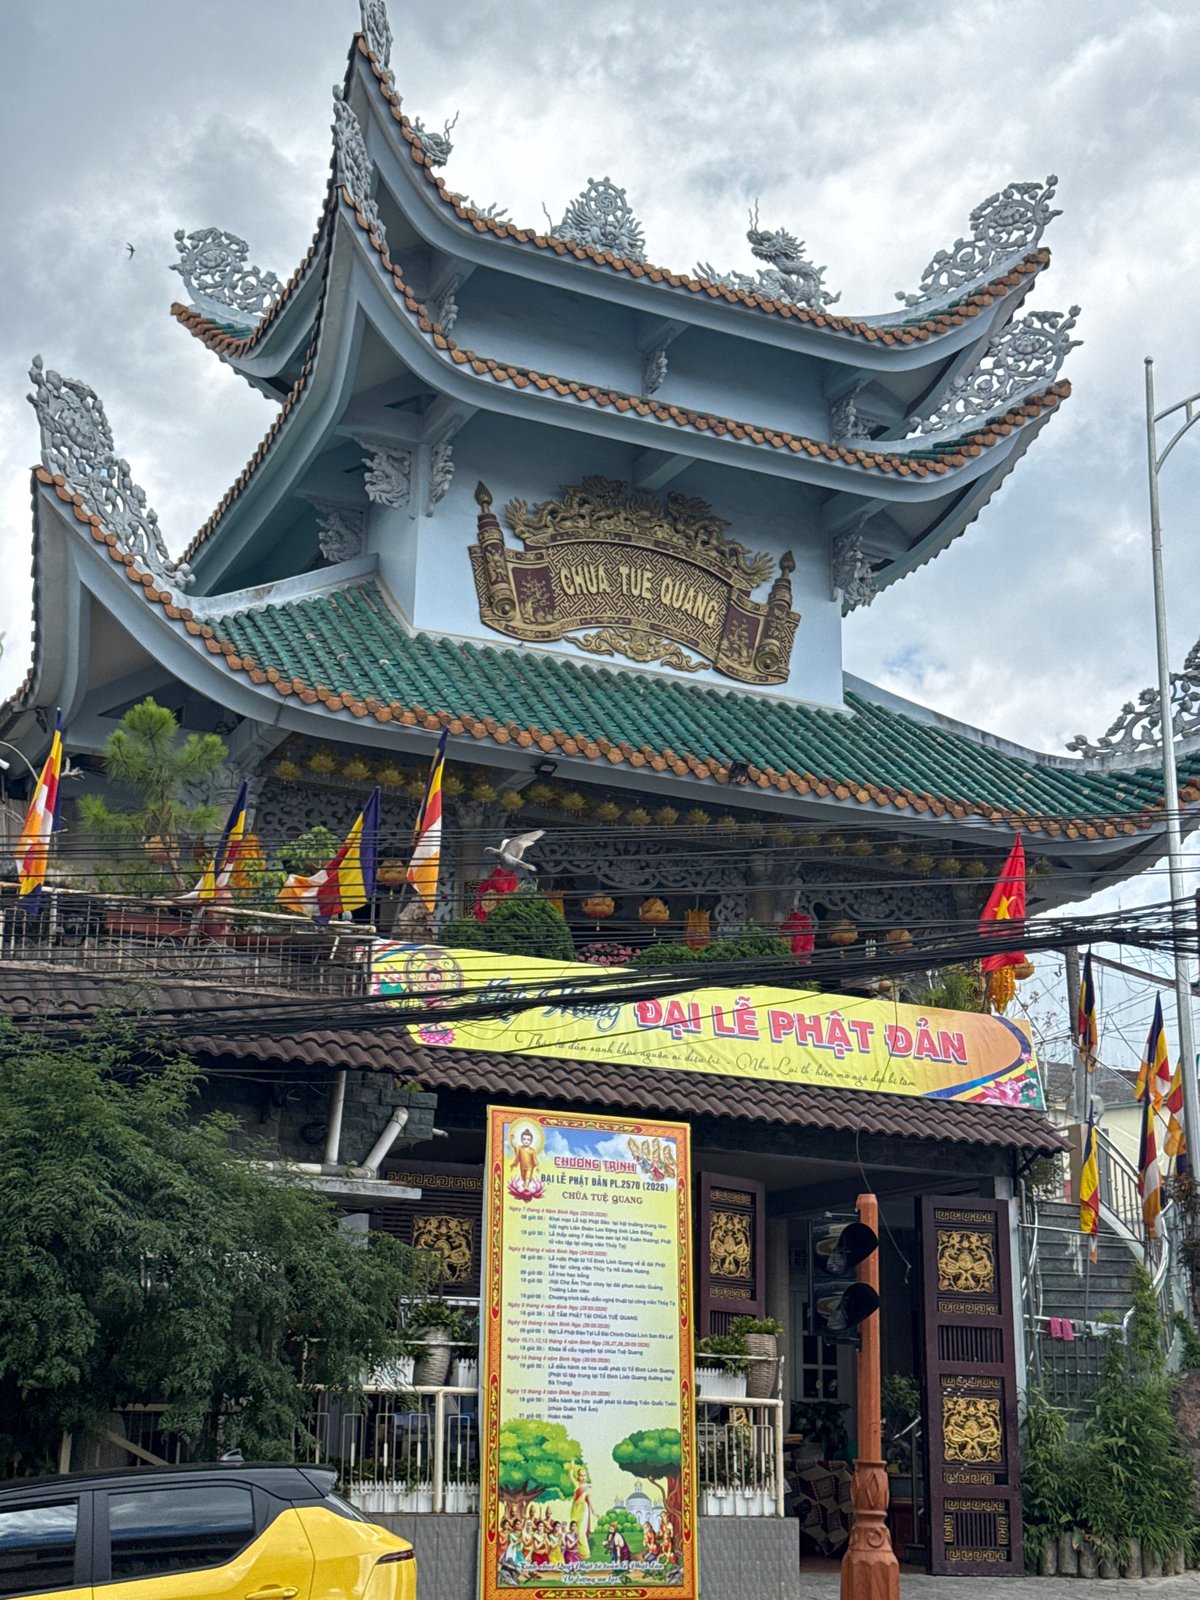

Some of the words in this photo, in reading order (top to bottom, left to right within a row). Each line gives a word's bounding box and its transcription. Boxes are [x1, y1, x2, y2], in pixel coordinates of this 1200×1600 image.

[560, 556, 610, 596] CHÙA
[619, 564, 653, 606] TUỆ
[660, 577, 718, 626] QUANG
[634, 999, 702, 1040] ĐẠI
[712, 996, 759, 1041] LỄ
[768, 1009, 874, 1060] PHẬT
[885, 1016, 968, 1065] ĐẢN
[589, 1042, 613, 1054] sanh
[736, 1052, 769, 1071] Như
[772, 1056, 798, 1075] Lai
[554, 1156, 600, 1171] CHƯƠNG
[603, 1159, 637, 1174] TRÌNH
[541, 1173, 554, 1185] ĐẠI
[556, 1172, 566, 1184] LỄ
[569, 1175, 589, 1188] PHẬT
[592, 1175, 608, 1187] ĐẢN
[610, 1180, 640, 1190] PL.2570
[642, 1181, 668, 1192] (2026)
[562, 1190, 588, 1201] CHÙA
[591, 1191, 608, 1203] TUỆ
[612, 1194, 643, 1205] QUANG
